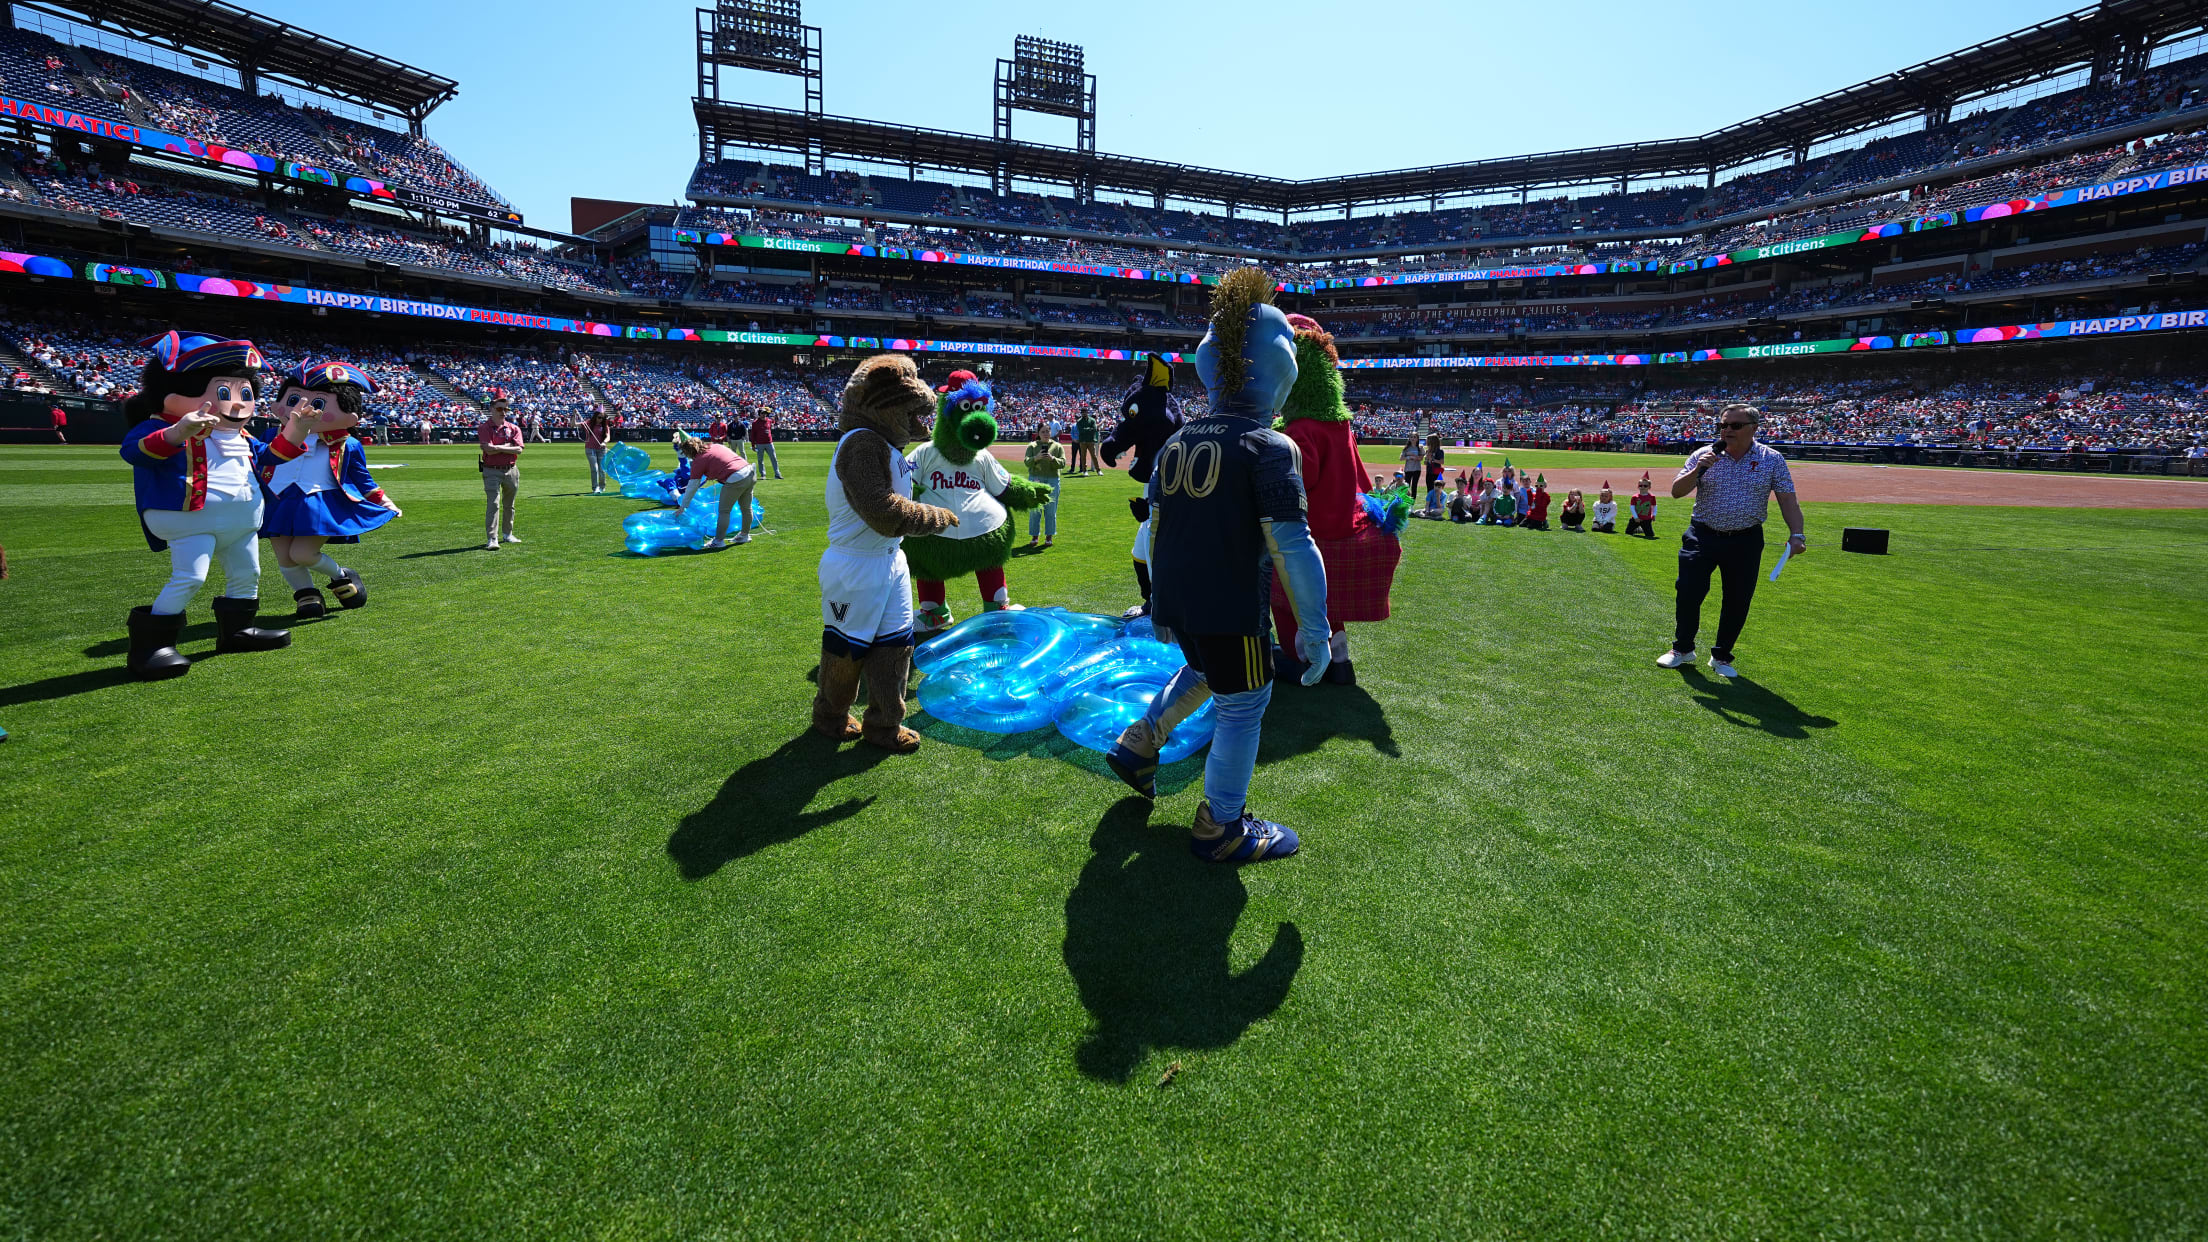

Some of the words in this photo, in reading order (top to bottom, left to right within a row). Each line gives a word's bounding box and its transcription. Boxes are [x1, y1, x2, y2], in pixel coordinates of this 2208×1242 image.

[2077, 174, 2162, 202] HAPPY
[446, 200, 460, 210] PM
[775, 239, 821, 252] Citizens
[1771, 239, 1826, 256] Citizens
[967, 255, 1001, 267] HAPPY
[1003, 258, 1050, 271] BIRTHDAY
[1052, 263, 1102, 275] PHANATIC!
[1404, 274, 1437, 284] HAPPY
[1438, 270, 1488, 281] BIRTHDAY
[1489, 268, 1546, 278] PHANATIC!
[306, 290, 375, 310] HAPPY
[380, 298, 466, 319] BIRTHDAY
[470, 309, 551, 329] PHANATIC!
[1426, 310, 1443, 319] THE
[2069, 315, 2155, 335] HAPPY
[740, 332, 787, 344] Citizens
[940, 342, 975, 352] HAPPY
[977, 344, 1027, 354] BIRTHDAY
[1029, 346, 1081, 357] PHANATIC!
[1761, 345, 1816, 356] Citizens
[1383, 359, 1421, 368] HAPPY
[1423, 357, 1482, 367] BIRTHDAY
[1485, 356, 1553, 367] PHANATIC!
[1182, 424, 1229, 435] PHANG
[1160, 440, 1222, 499] 00
[930, 470, 981, 490] Phillies
